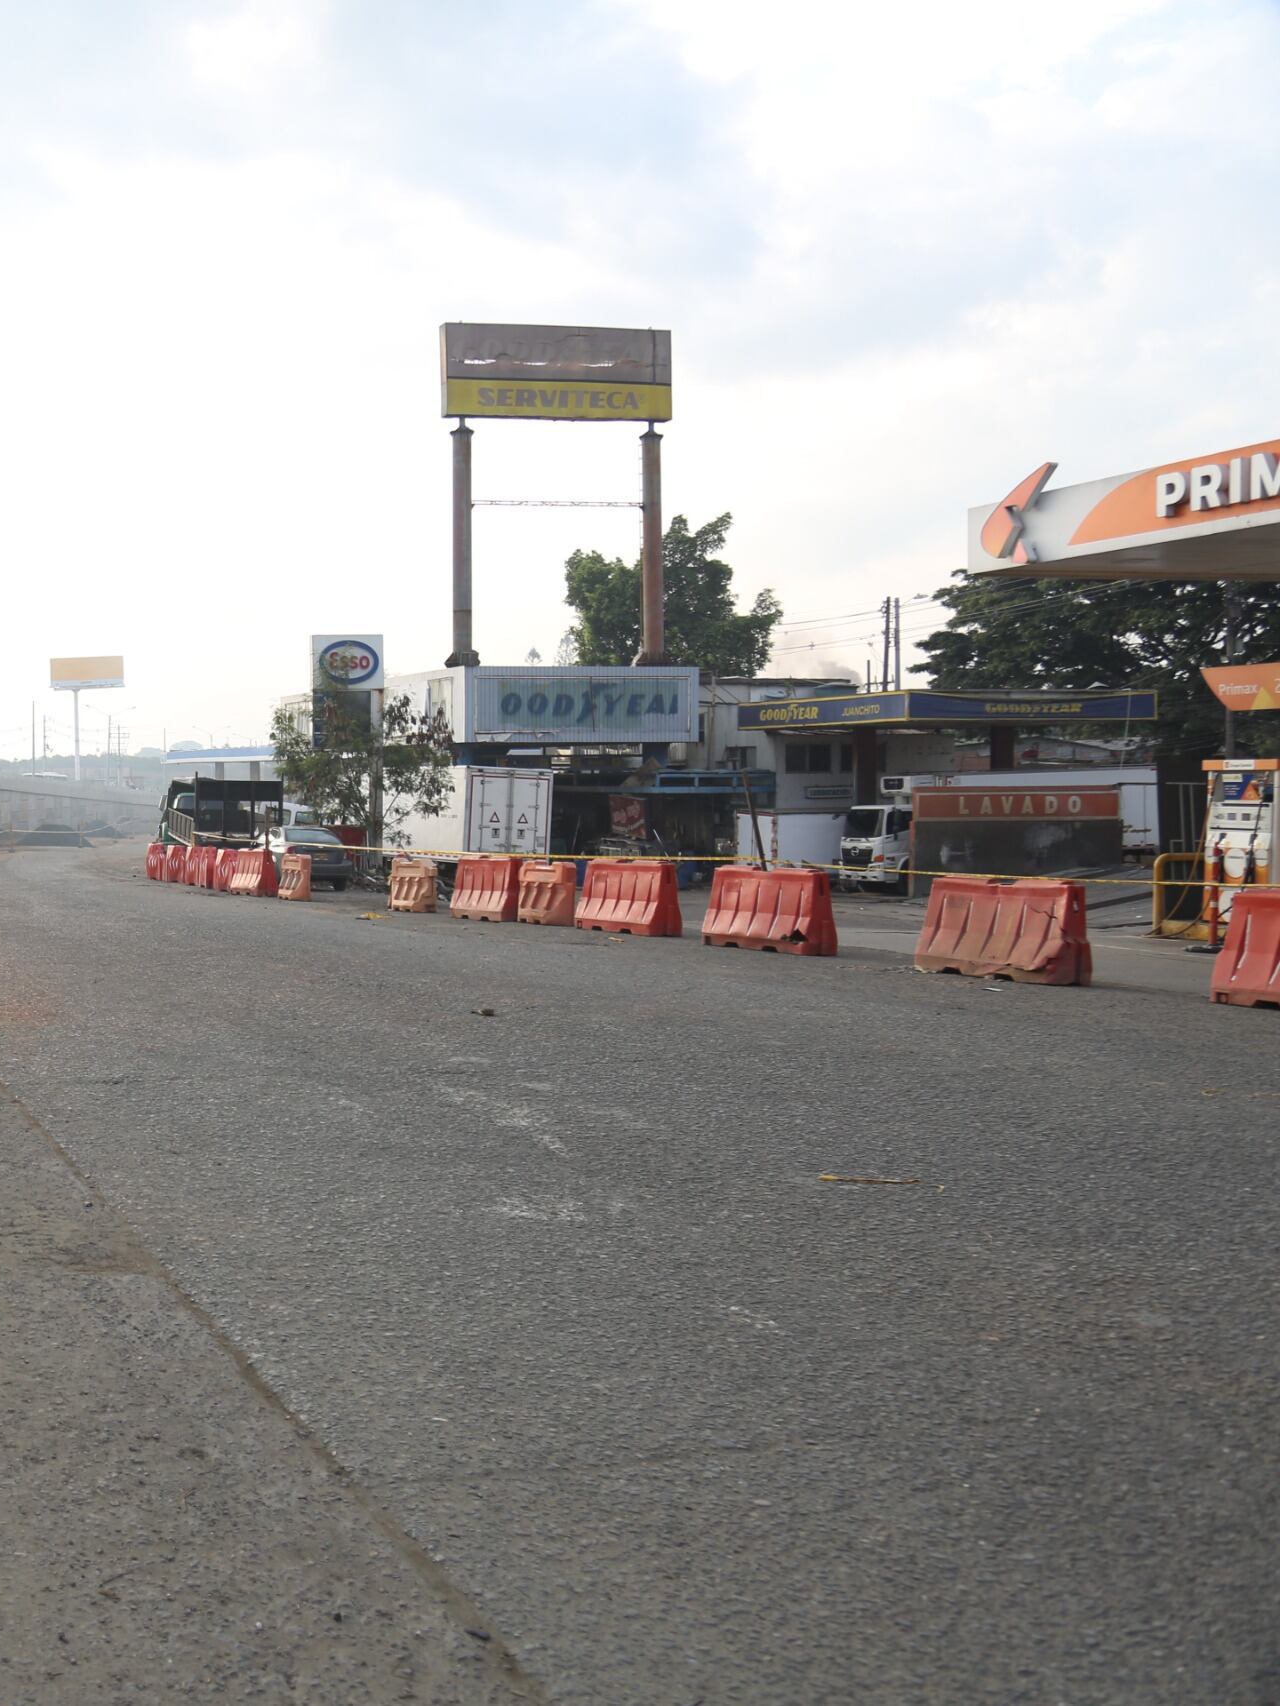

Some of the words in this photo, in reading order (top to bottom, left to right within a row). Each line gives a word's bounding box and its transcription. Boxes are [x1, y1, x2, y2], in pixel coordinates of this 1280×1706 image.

[478, 387, 640, 410] SERVITECA
[1218, 683, 1259, 695] Primax
[759, 705, 820, 721] GOODYEAR
[842, 704, 881, 717] JUANCHITO
[959, 795, 1081, 815] LAVADO
